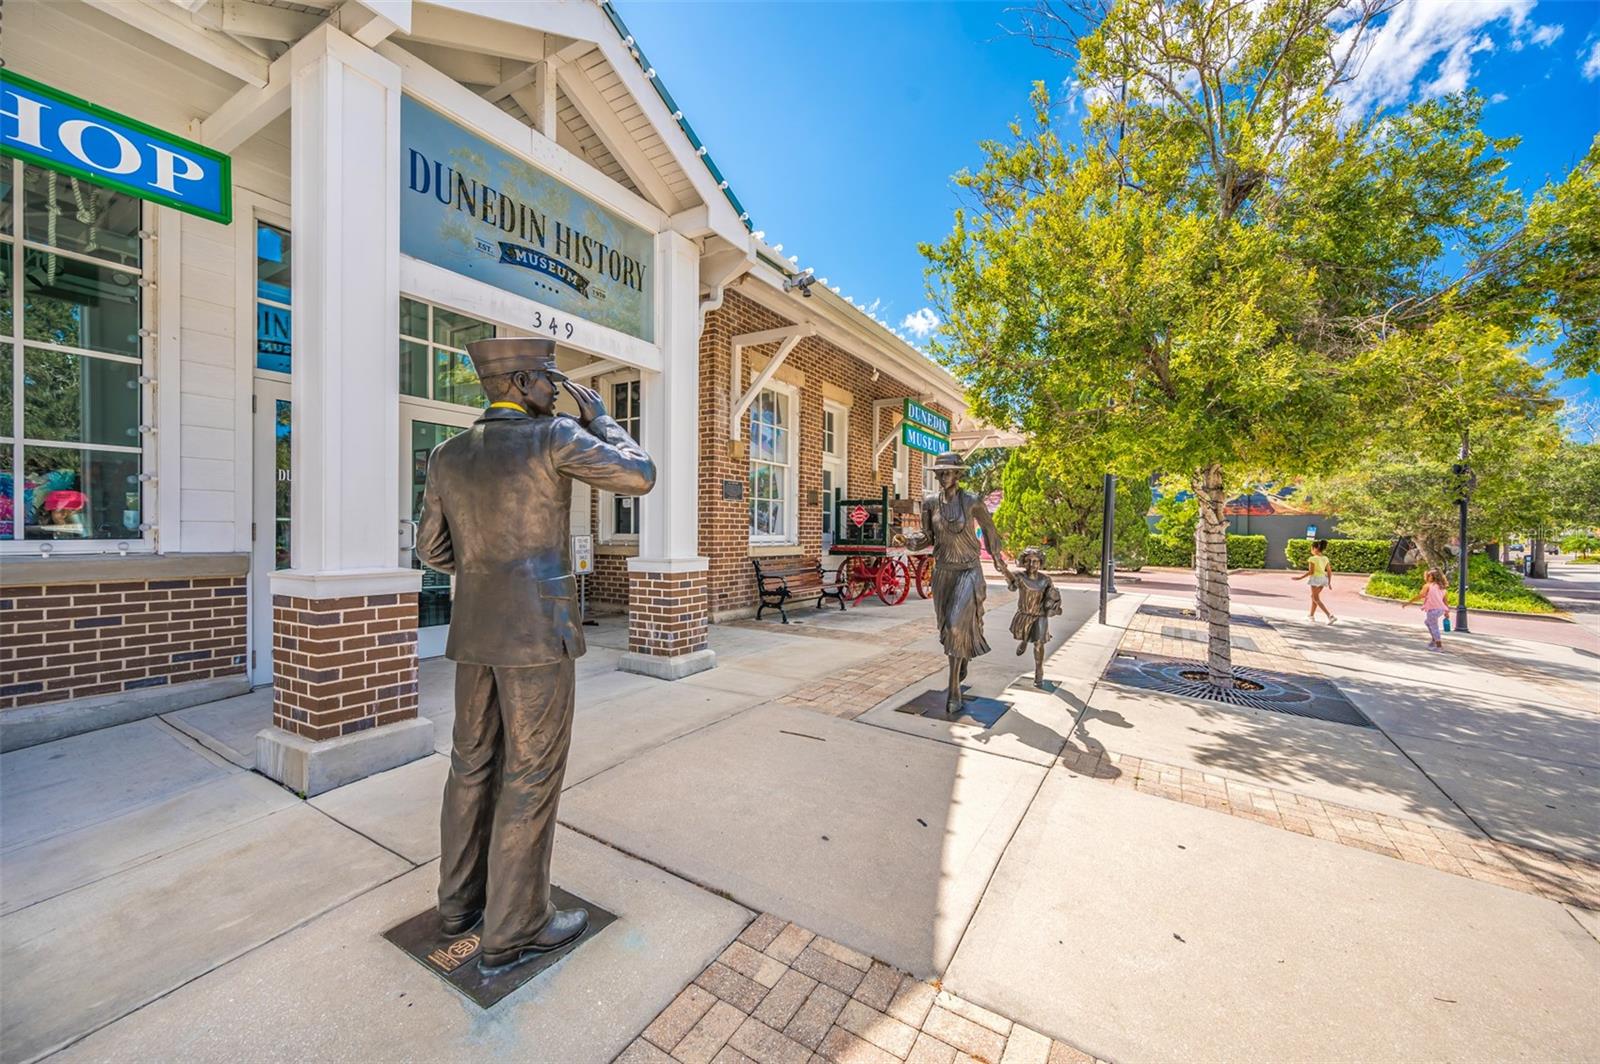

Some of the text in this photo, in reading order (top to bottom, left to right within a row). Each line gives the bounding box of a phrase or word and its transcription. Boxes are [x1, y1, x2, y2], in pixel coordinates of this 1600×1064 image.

[408, 147, 647, 293] DUNEDIN HISTORY
[477, 241, 493, 254] EST.
[515, 248, 579, 286] MUSEUM
[257, 310, 289, 339] IN
[532, 311, 574, 339] 349
[908, 402, 948, 434] DUNEDIN
[907, 428, 946, 454] MUSEUM
